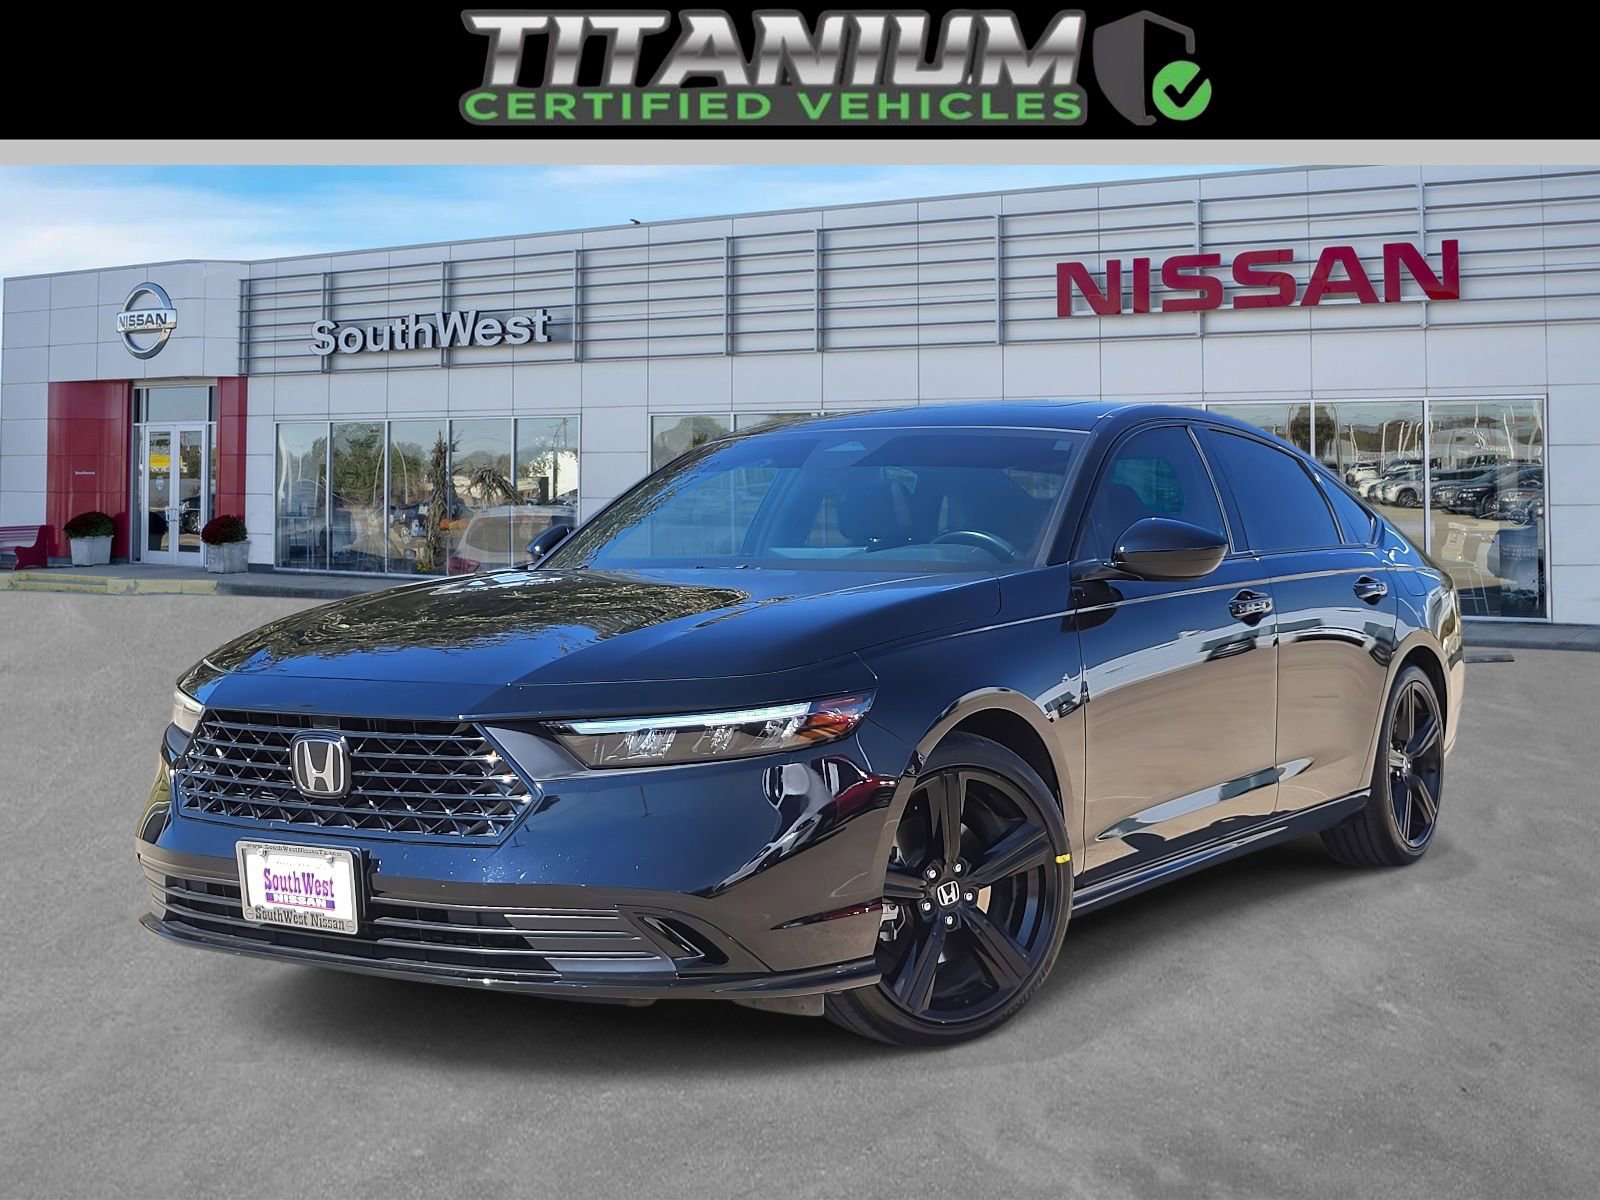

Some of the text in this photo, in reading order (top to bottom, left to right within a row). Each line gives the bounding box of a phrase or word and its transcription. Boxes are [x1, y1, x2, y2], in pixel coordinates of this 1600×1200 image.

[1056, 239, 1460, 317] NISSAN
[118, 312, 167, 329] NISSAN
[309, 308, 551, 356] SouthWest
[263, 867, 334, 897] SouthWest
[274, 893, 325, 908] NISSAN
[255, 906, 345, 931] SouthWest Nissan
